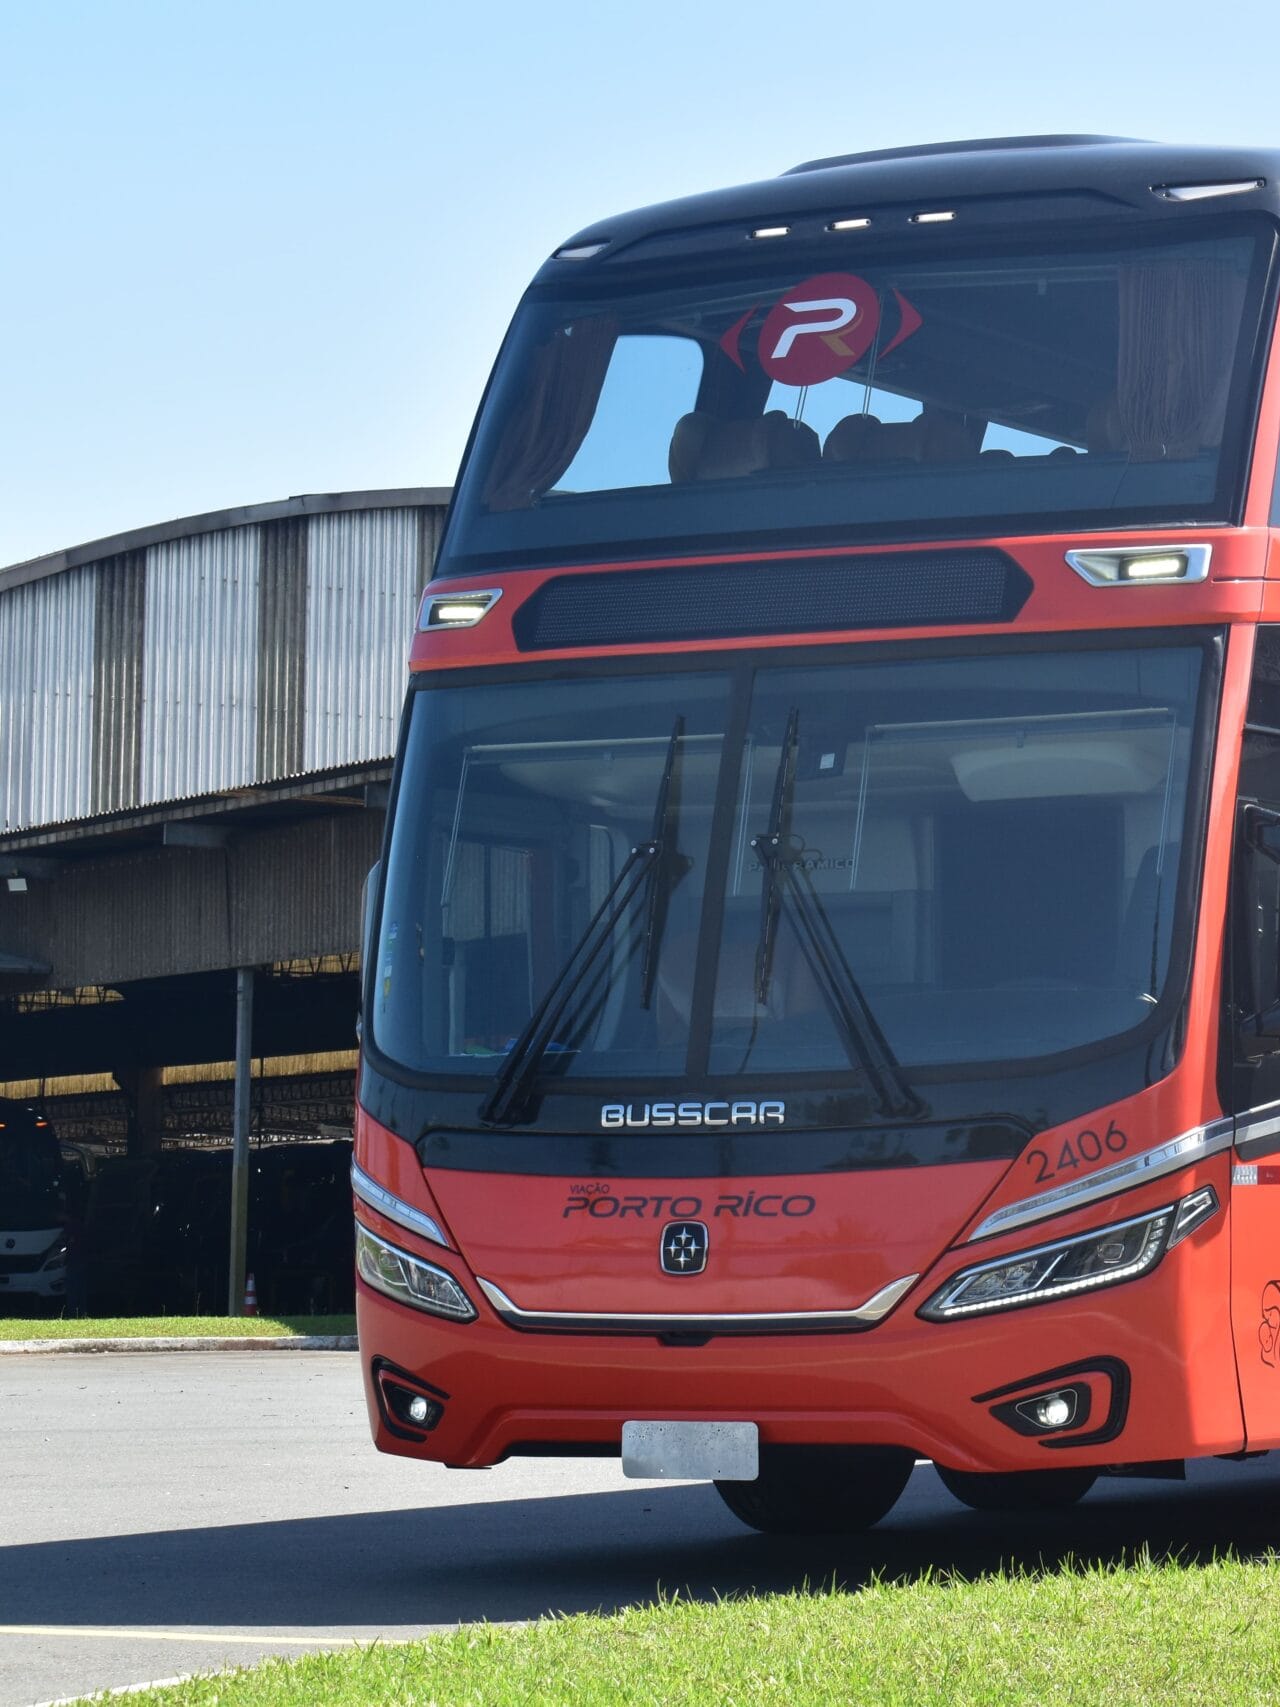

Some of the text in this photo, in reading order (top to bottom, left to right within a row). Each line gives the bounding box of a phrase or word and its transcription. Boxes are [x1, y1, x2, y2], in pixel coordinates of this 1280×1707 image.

[601, 1101, 785, 1128] BUSSCAR
[1027, 1119, 1127, 1183] 2406
[570, 1183, 610, 1195] VIAÇÃO
[562, 1196, 702, 1218] PORTO
